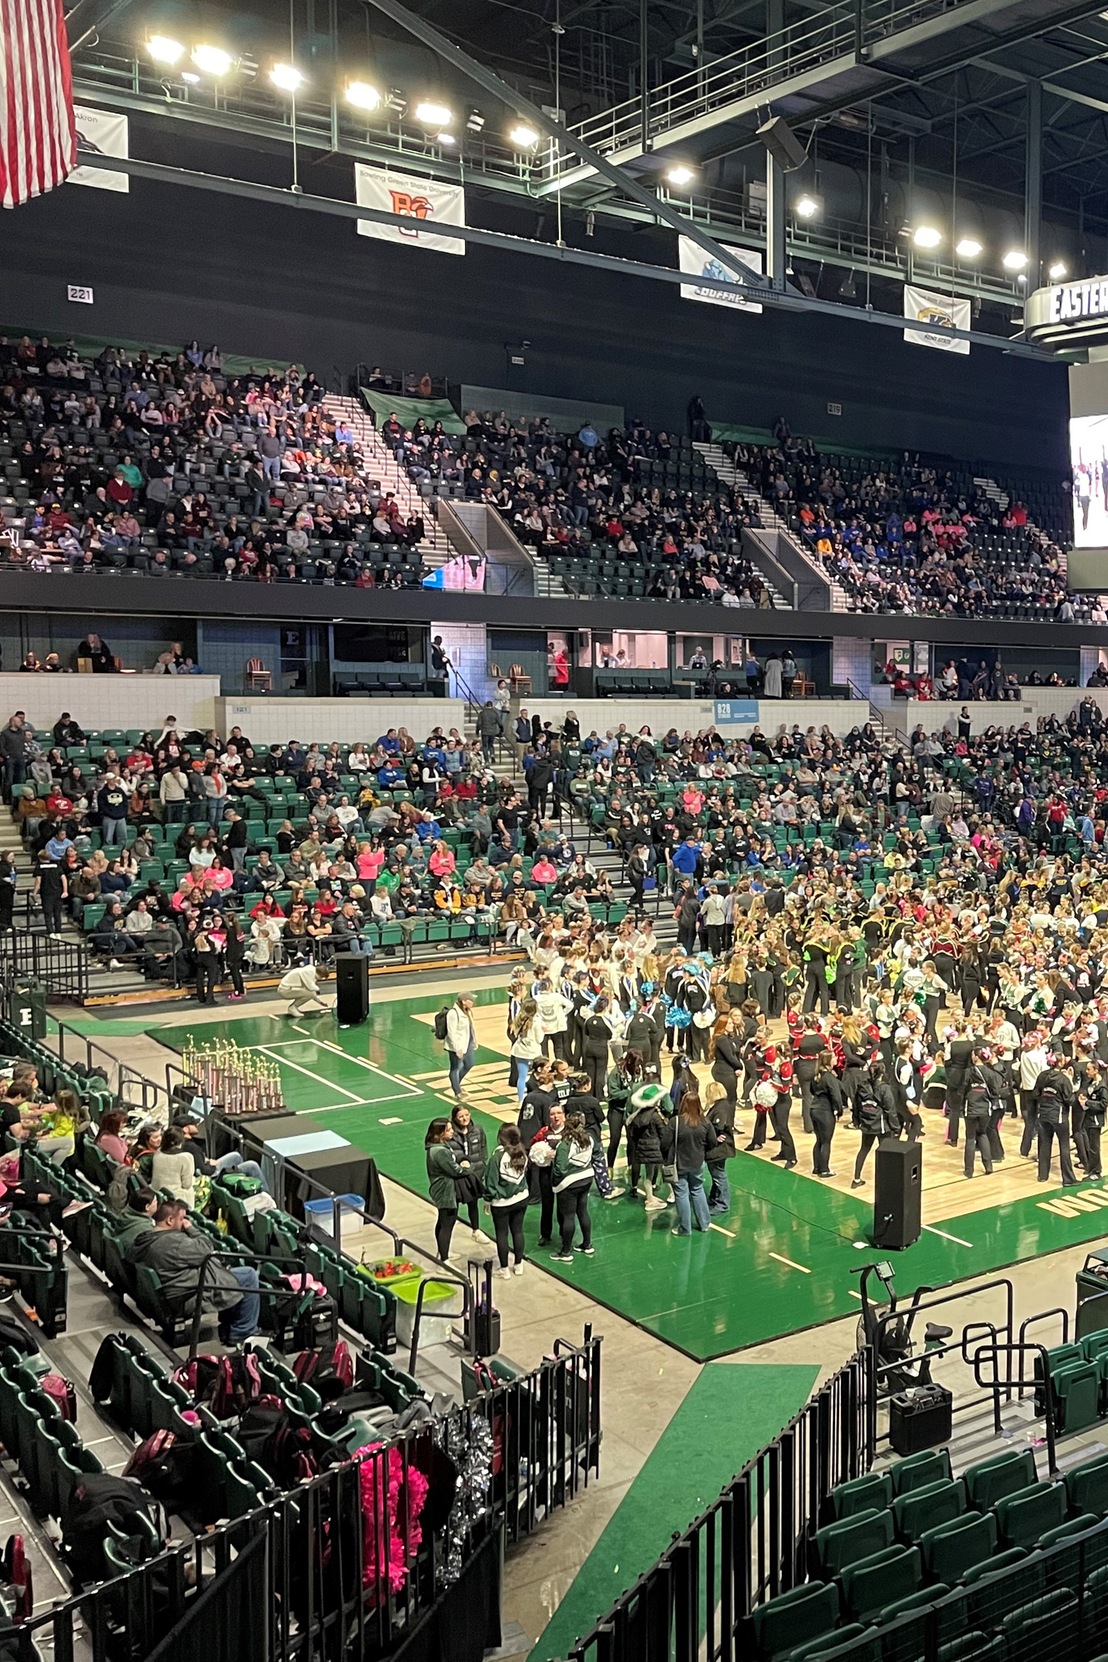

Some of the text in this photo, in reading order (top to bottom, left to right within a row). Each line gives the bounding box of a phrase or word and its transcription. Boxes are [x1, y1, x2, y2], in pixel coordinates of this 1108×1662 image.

[75, 113, 98, 123] Akron
[360, 170, 386, 182] Bowling
[388, 176, 408, 186] Green
[410, 181, 427, 190] State
[70, 288, 90, 300] 221
[286, 631, 299, 644] E
[20, 1008, 32, 1026] E
